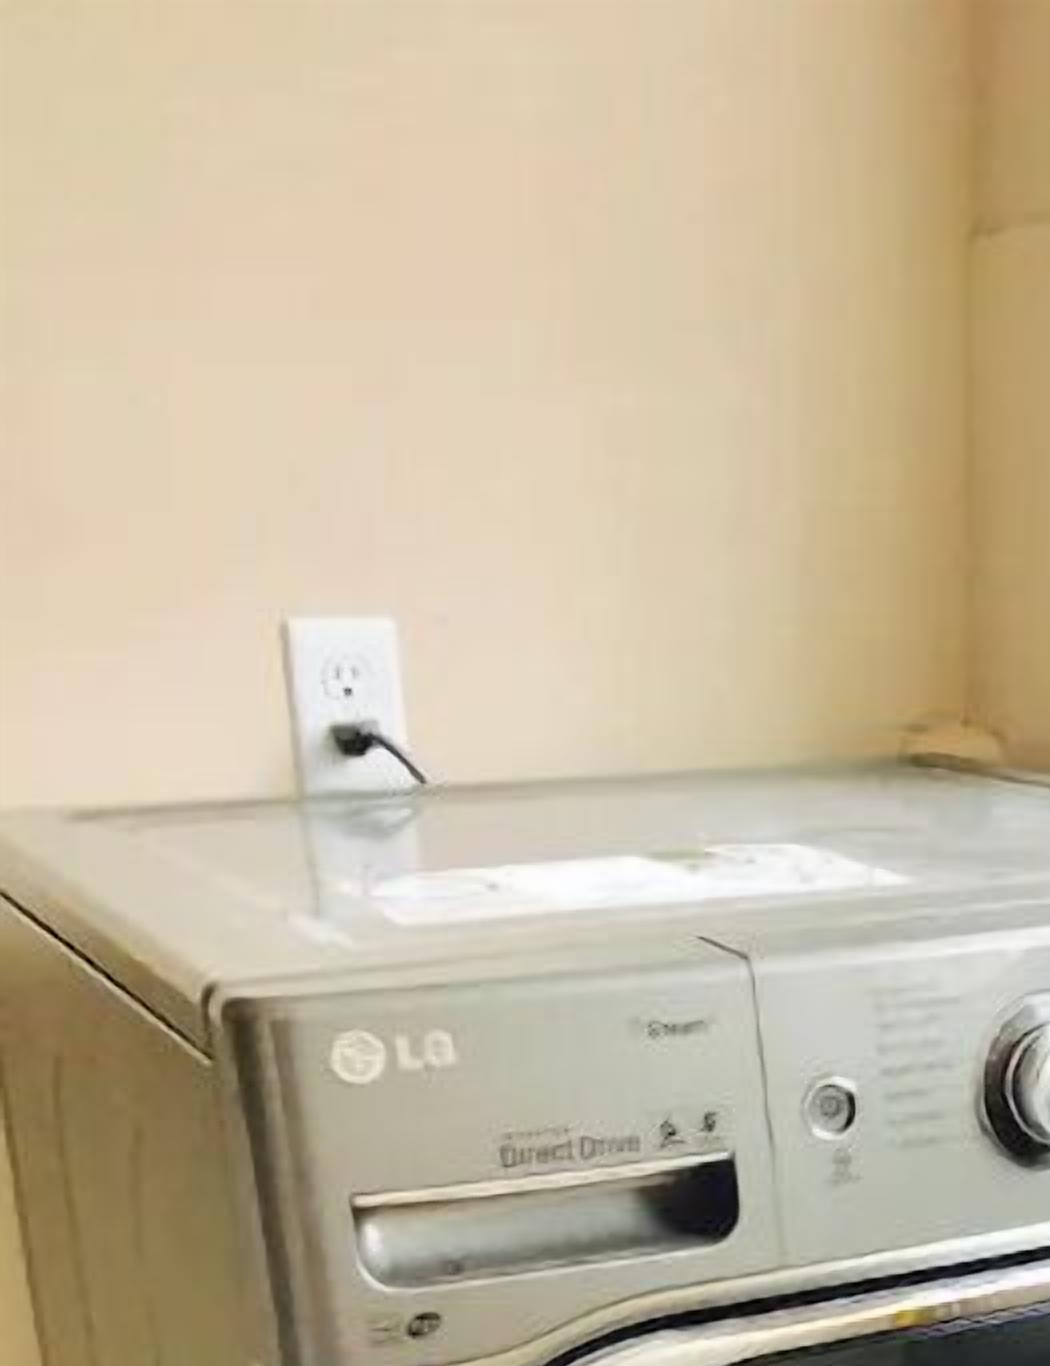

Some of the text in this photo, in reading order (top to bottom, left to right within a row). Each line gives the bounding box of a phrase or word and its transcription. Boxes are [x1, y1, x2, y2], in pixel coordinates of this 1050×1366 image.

[395, 1030, 457, 1069] LG
[499, 1134, 641, 1168] Direct Drive
